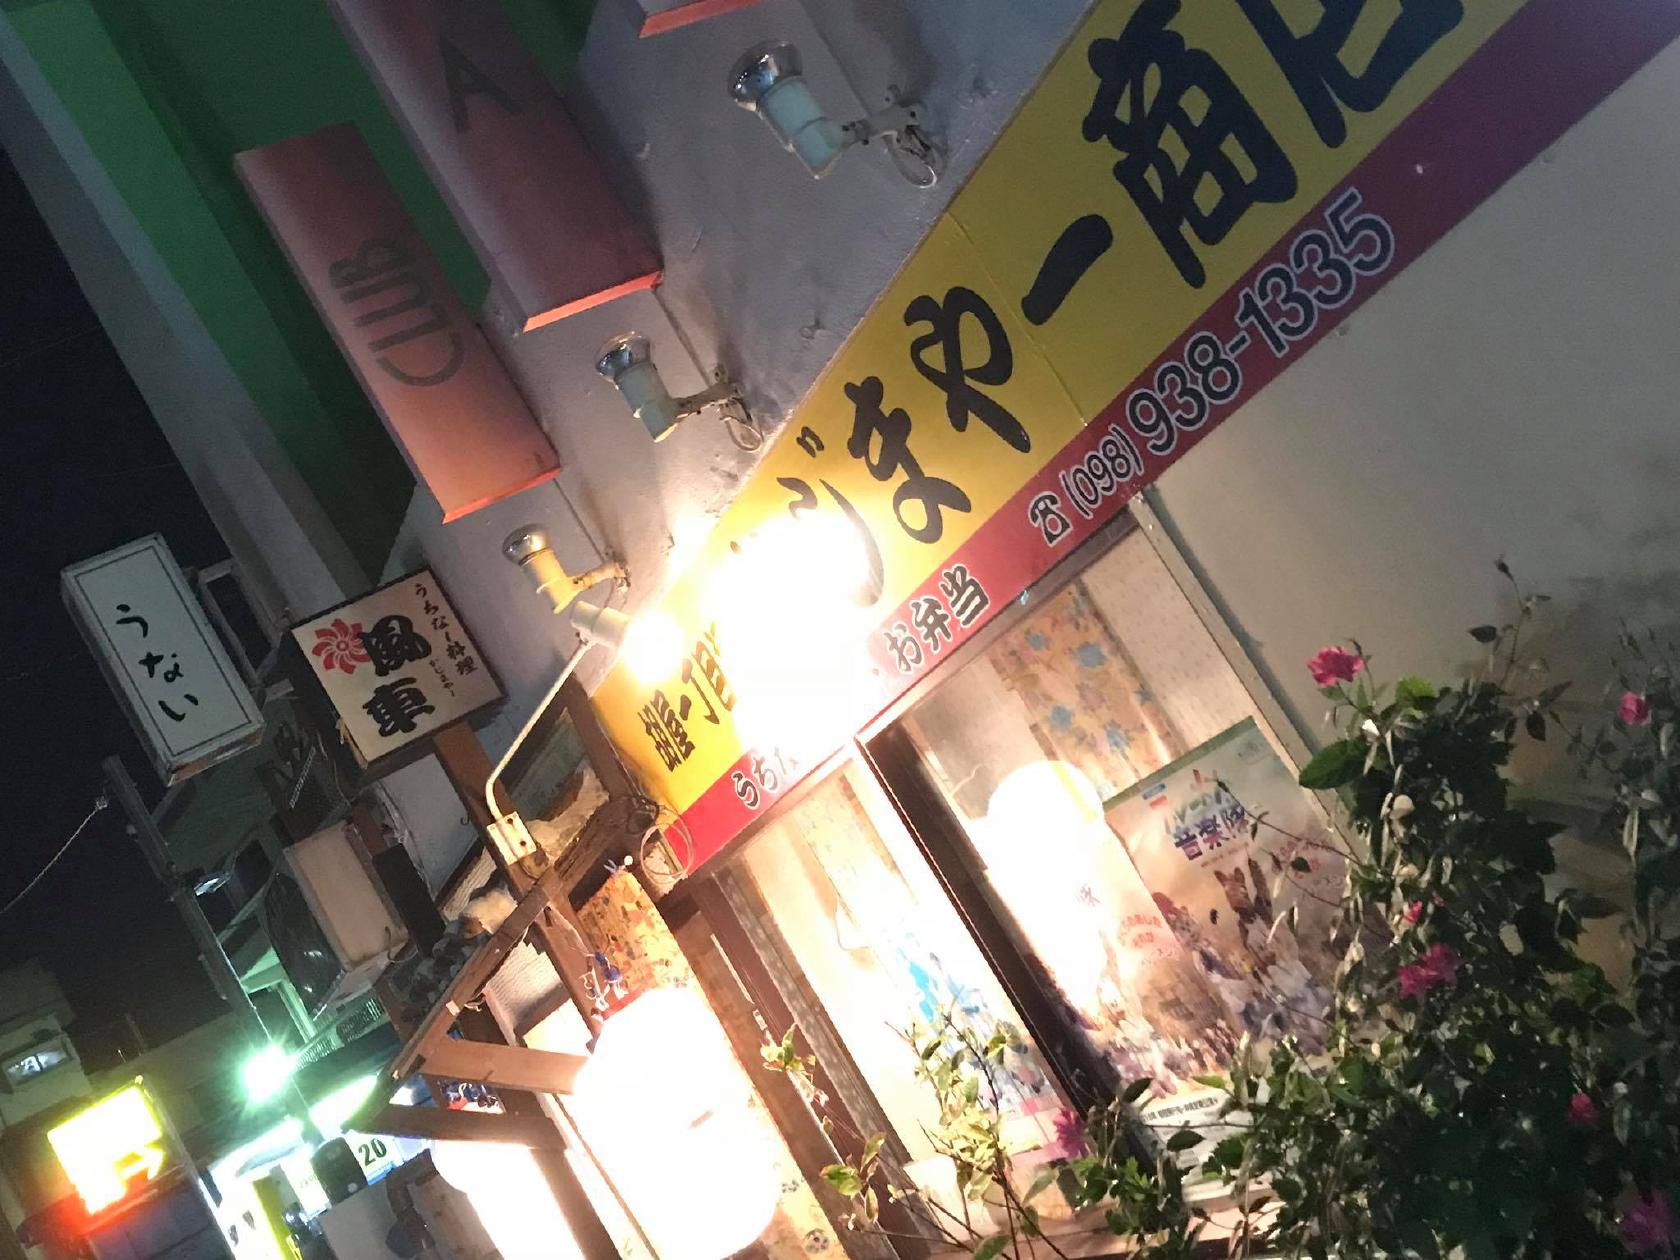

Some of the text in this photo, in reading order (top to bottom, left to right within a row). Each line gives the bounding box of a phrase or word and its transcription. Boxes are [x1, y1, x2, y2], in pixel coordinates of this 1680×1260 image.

[328, 238, 465, 387] CLUB
[1126, 186, 1395, 455] 938-1335
[116, 604, 199, 722] うない
[358, 614, 436, 738] 風車
[415, 583, 478, 675] うちなー料理
[428, 659, 456, 697] かじまやー
[637, 621, 738, 773] 胡屋一丁目
[357, 1137, 388, 1167] 20
